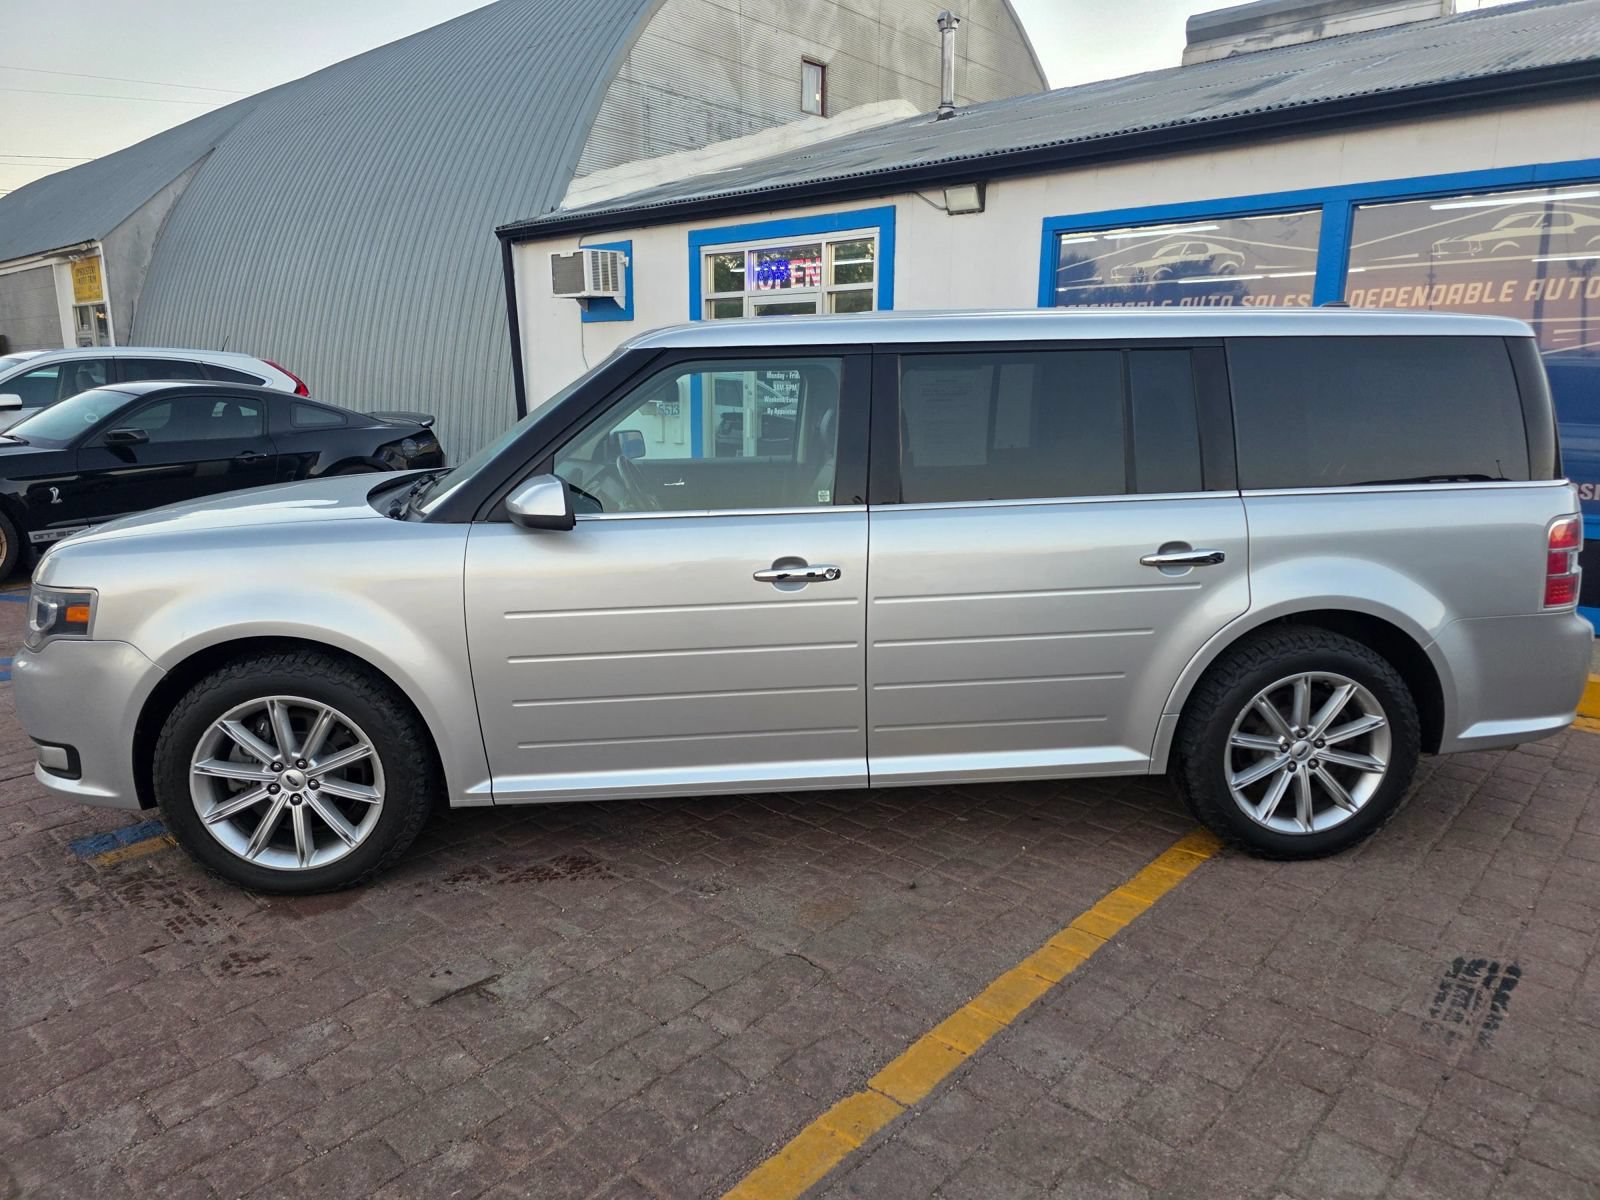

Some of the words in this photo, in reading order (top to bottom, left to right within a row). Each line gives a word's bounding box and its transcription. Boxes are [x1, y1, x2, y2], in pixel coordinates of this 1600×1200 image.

[758, 257, 821, 290] OPEN
[1349, 279, 1518, 308] DEPENDABLE
[1524, 275, 1600, 301] AUTO
[658, 403, 680, 416] 5513
